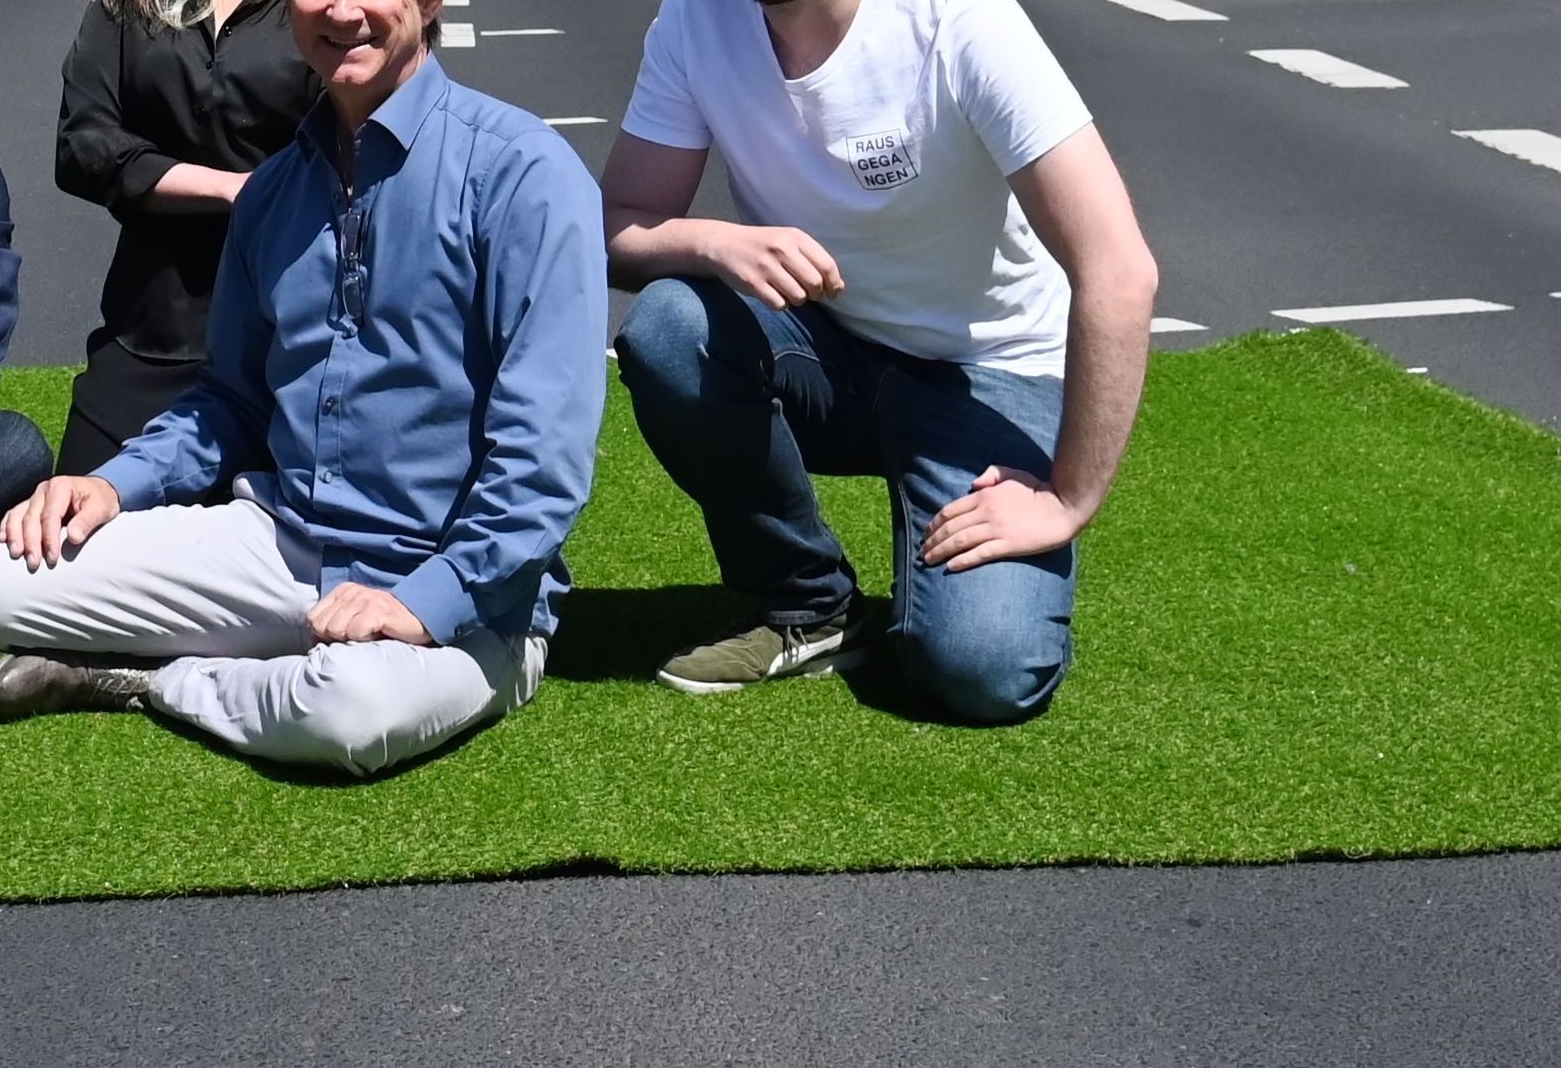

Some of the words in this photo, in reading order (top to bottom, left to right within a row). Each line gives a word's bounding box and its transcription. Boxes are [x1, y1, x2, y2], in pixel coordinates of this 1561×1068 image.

[855, 135, 895, 154] RAUS
[857, 153, 903, 171] GEGA
[864, 167, 909, 187] NGEN
